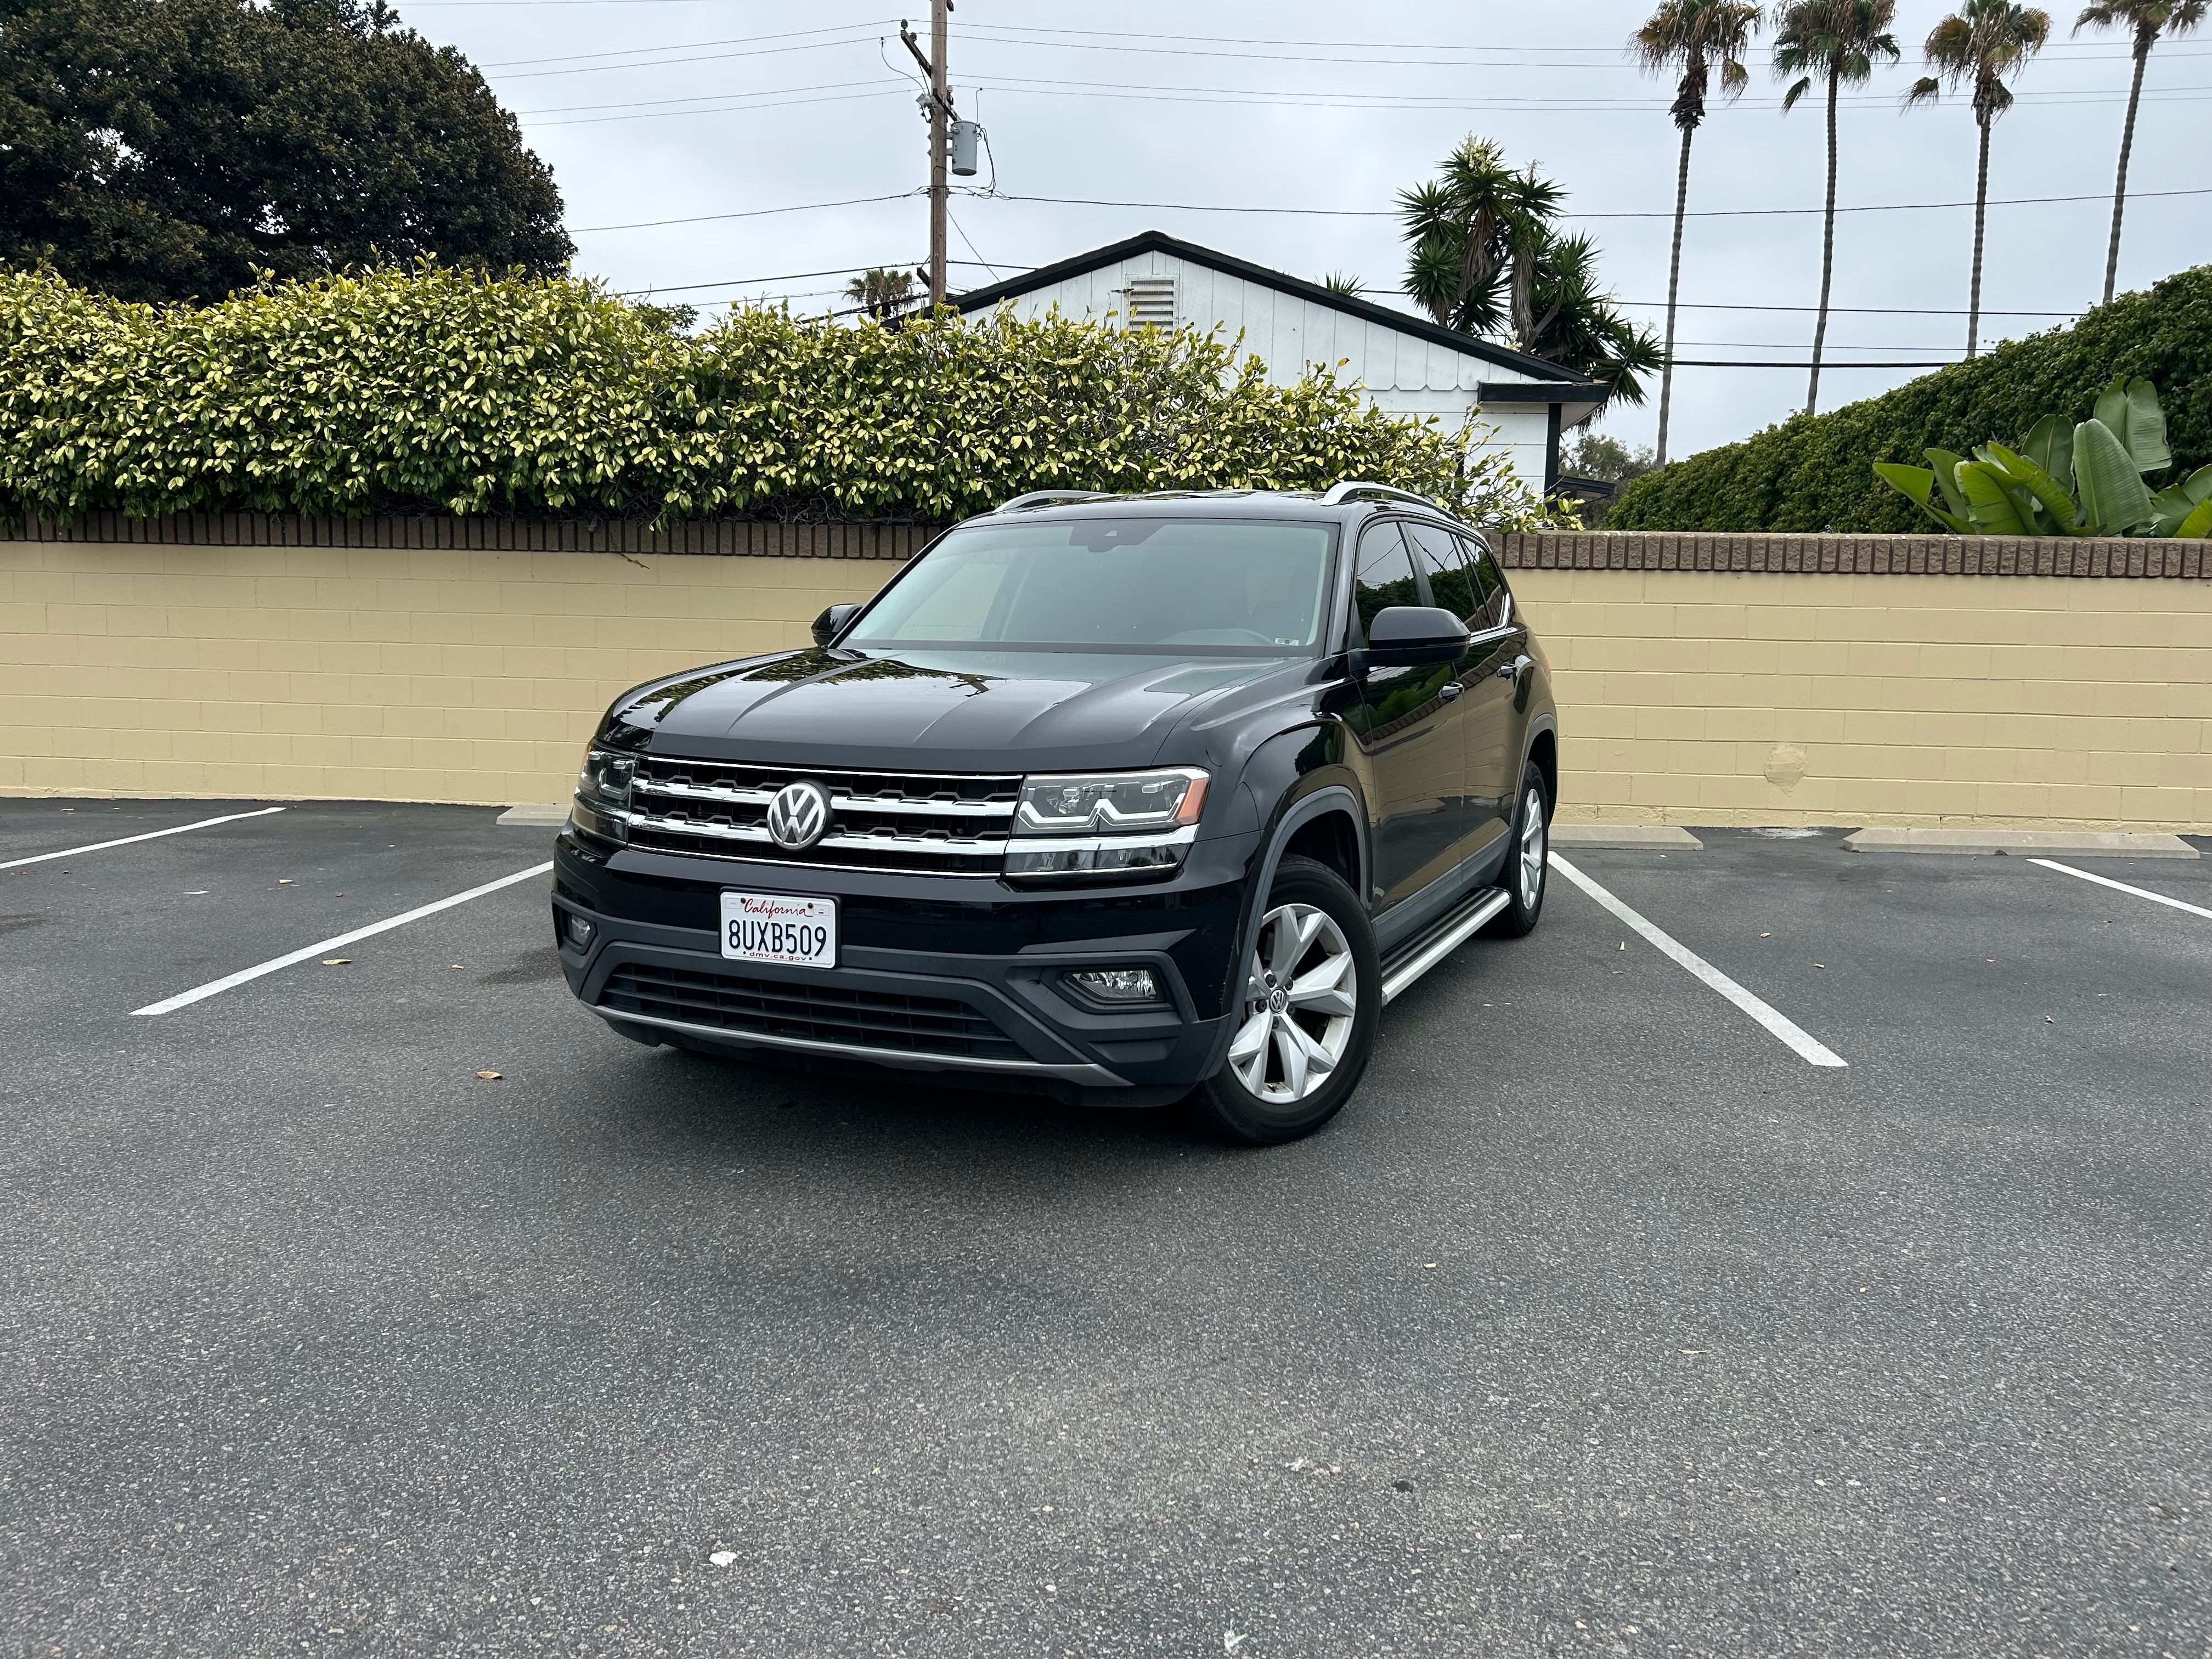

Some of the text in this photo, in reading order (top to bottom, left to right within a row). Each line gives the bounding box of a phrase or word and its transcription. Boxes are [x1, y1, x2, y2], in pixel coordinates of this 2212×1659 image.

[771, 786, 823, 846] VW
[744, 899, 814, 919] California
[729, 919, 826, 956] 8UXB509
[749, 951, 806, 961] dmv.ca.gov
[1271, 990, 1285, 1011] VW
